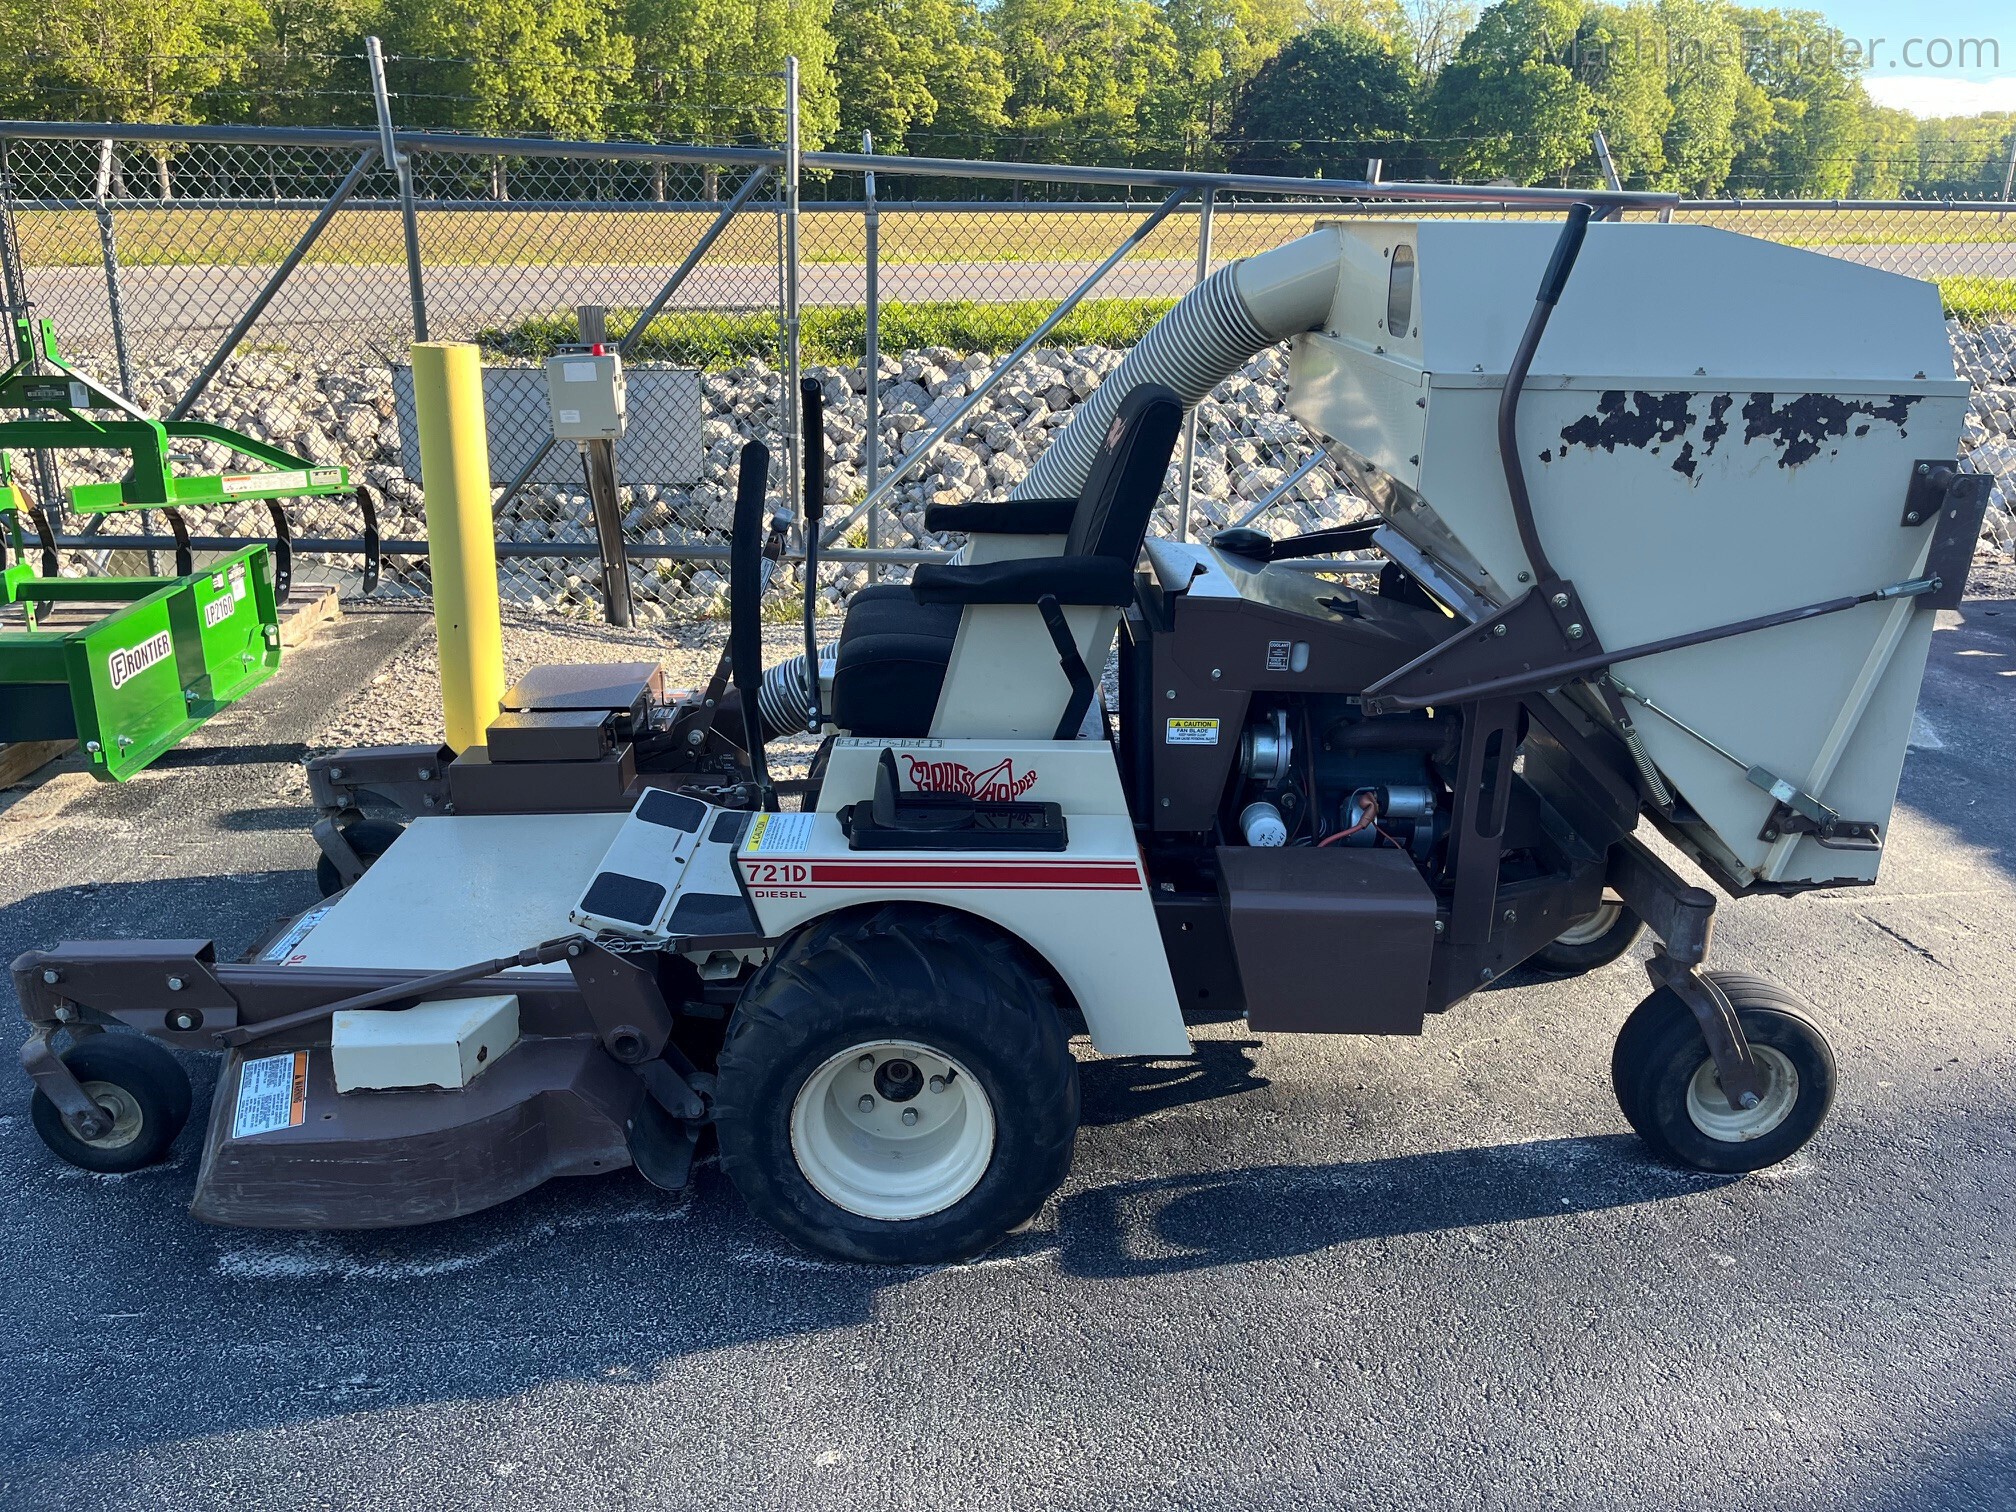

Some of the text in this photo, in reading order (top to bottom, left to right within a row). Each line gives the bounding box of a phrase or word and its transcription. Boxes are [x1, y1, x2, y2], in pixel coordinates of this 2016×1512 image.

[206, 595, 234, 626] LP2160
[111, 634, 170, 686] FRONTIER
[751, 821, 766, 840] CAUTION
[746, 864, 807, 882] 721D
[755, 890, 807, 899] DIESEL
